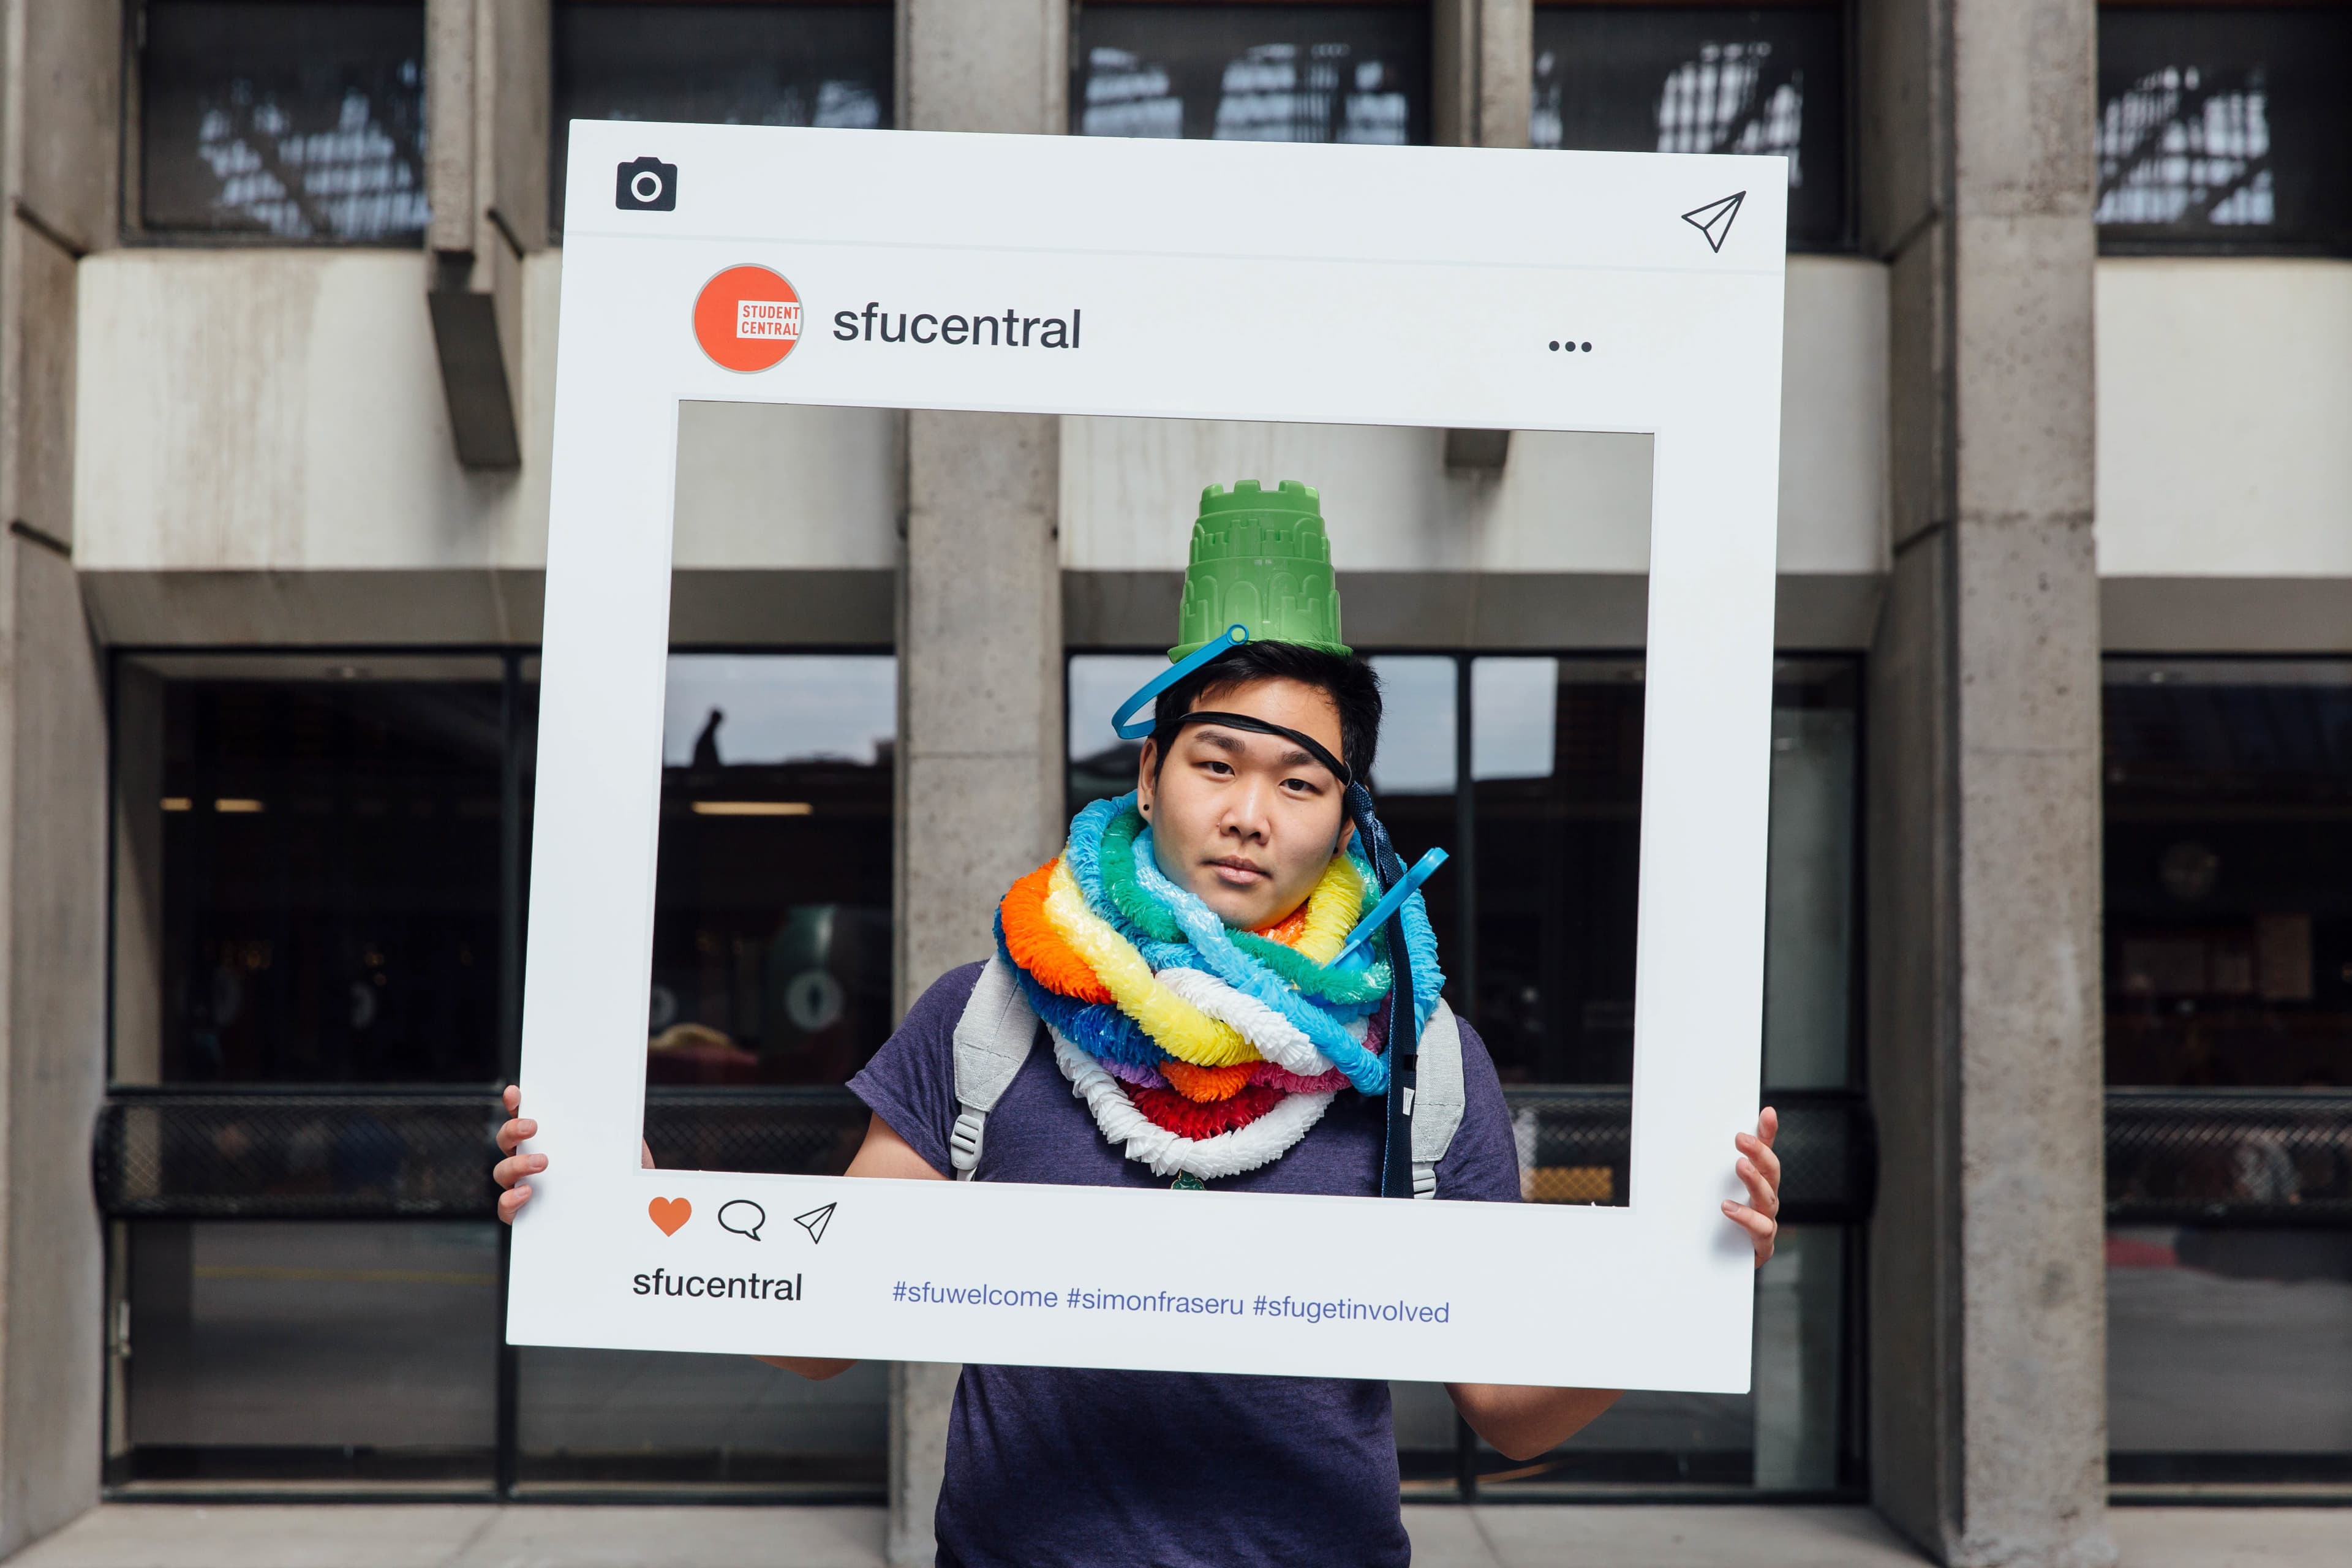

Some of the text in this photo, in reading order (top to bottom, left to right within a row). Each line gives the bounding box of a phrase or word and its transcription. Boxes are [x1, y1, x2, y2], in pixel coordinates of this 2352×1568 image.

[741, 322, 799, 336] CENTRAL
[742, 305, 801, 319] STUDENT
[833, 302, 1080, 349] sfucentral
[633, 1267, 802, 1301] sfucentral
[892, 1281, 1450, 1324] #sfuwelcome #simonfraseru #sfugetinvolved
